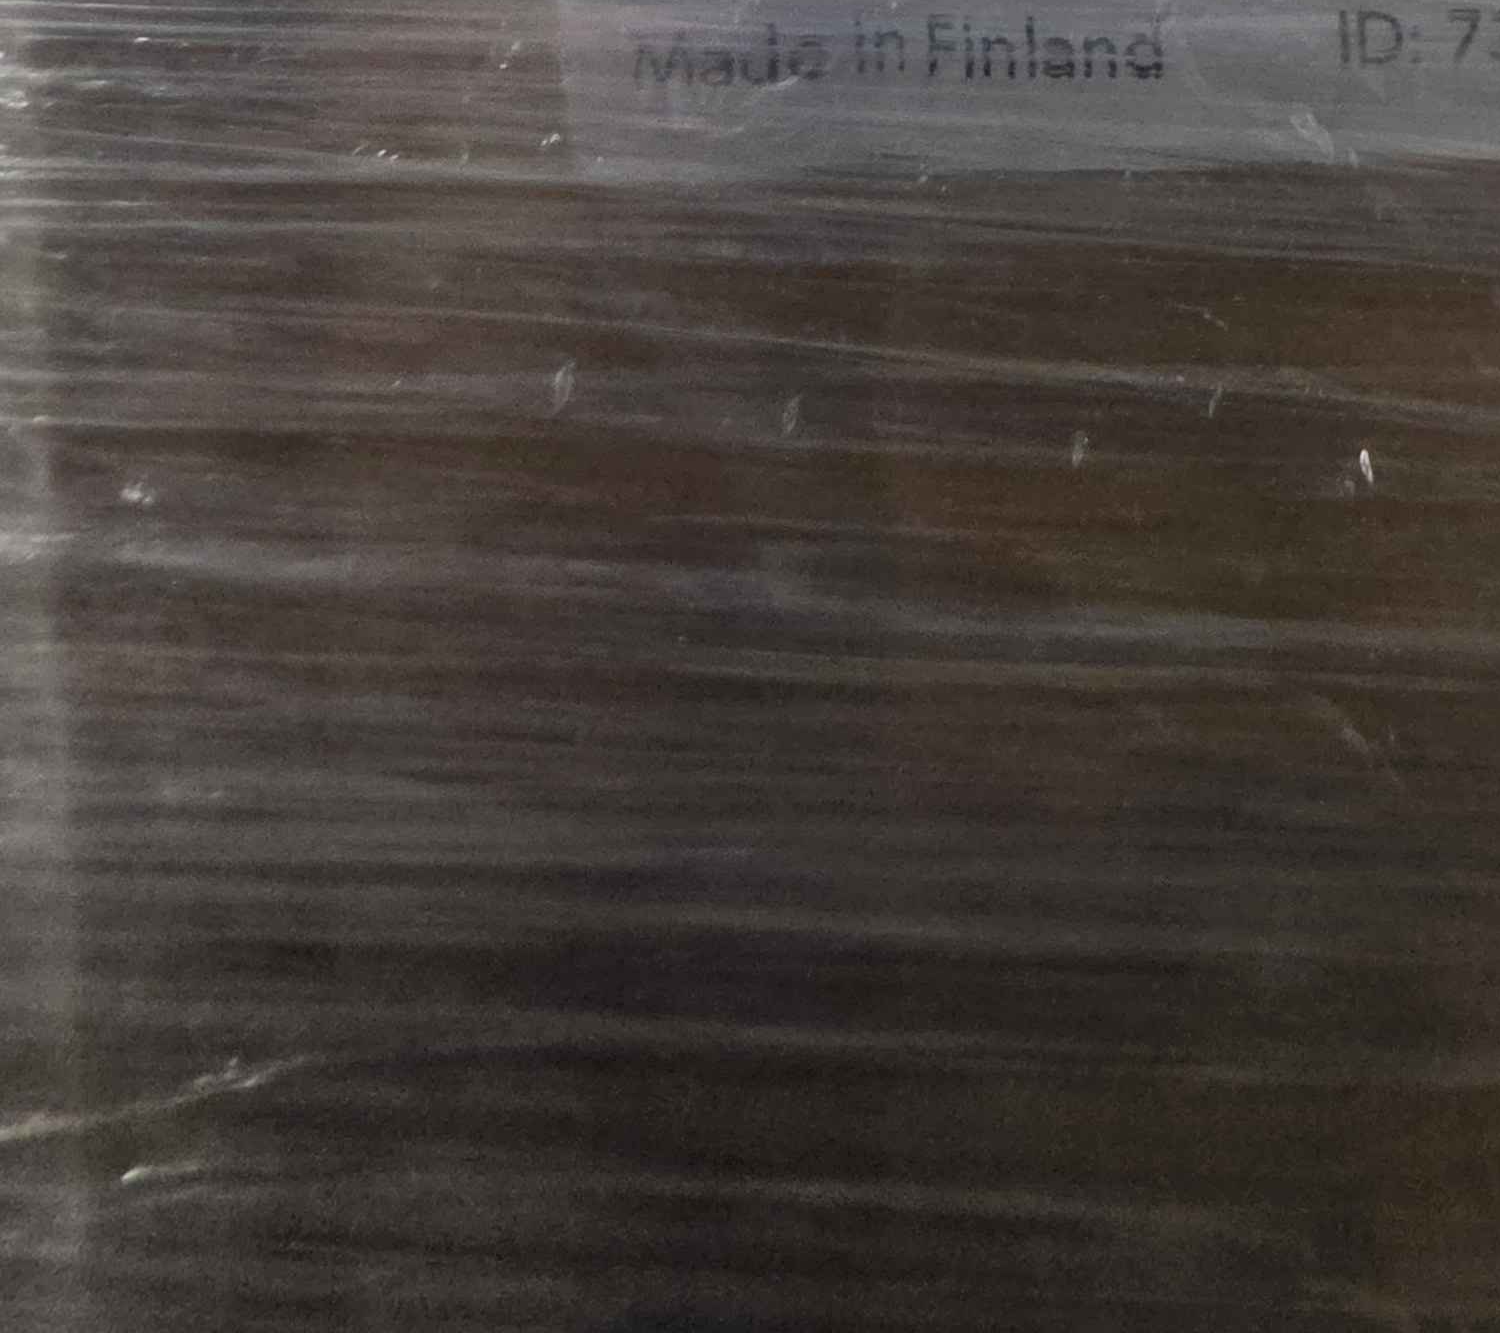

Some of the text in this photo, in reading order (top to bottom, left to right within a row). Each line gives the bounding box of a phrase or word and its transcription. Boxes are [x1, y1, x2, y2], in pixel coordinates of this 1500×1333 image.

[853, 16, 906, 76] in
[925, 12, 1167, 81] Finland
[1337, 6, 1421, 70] ID:
